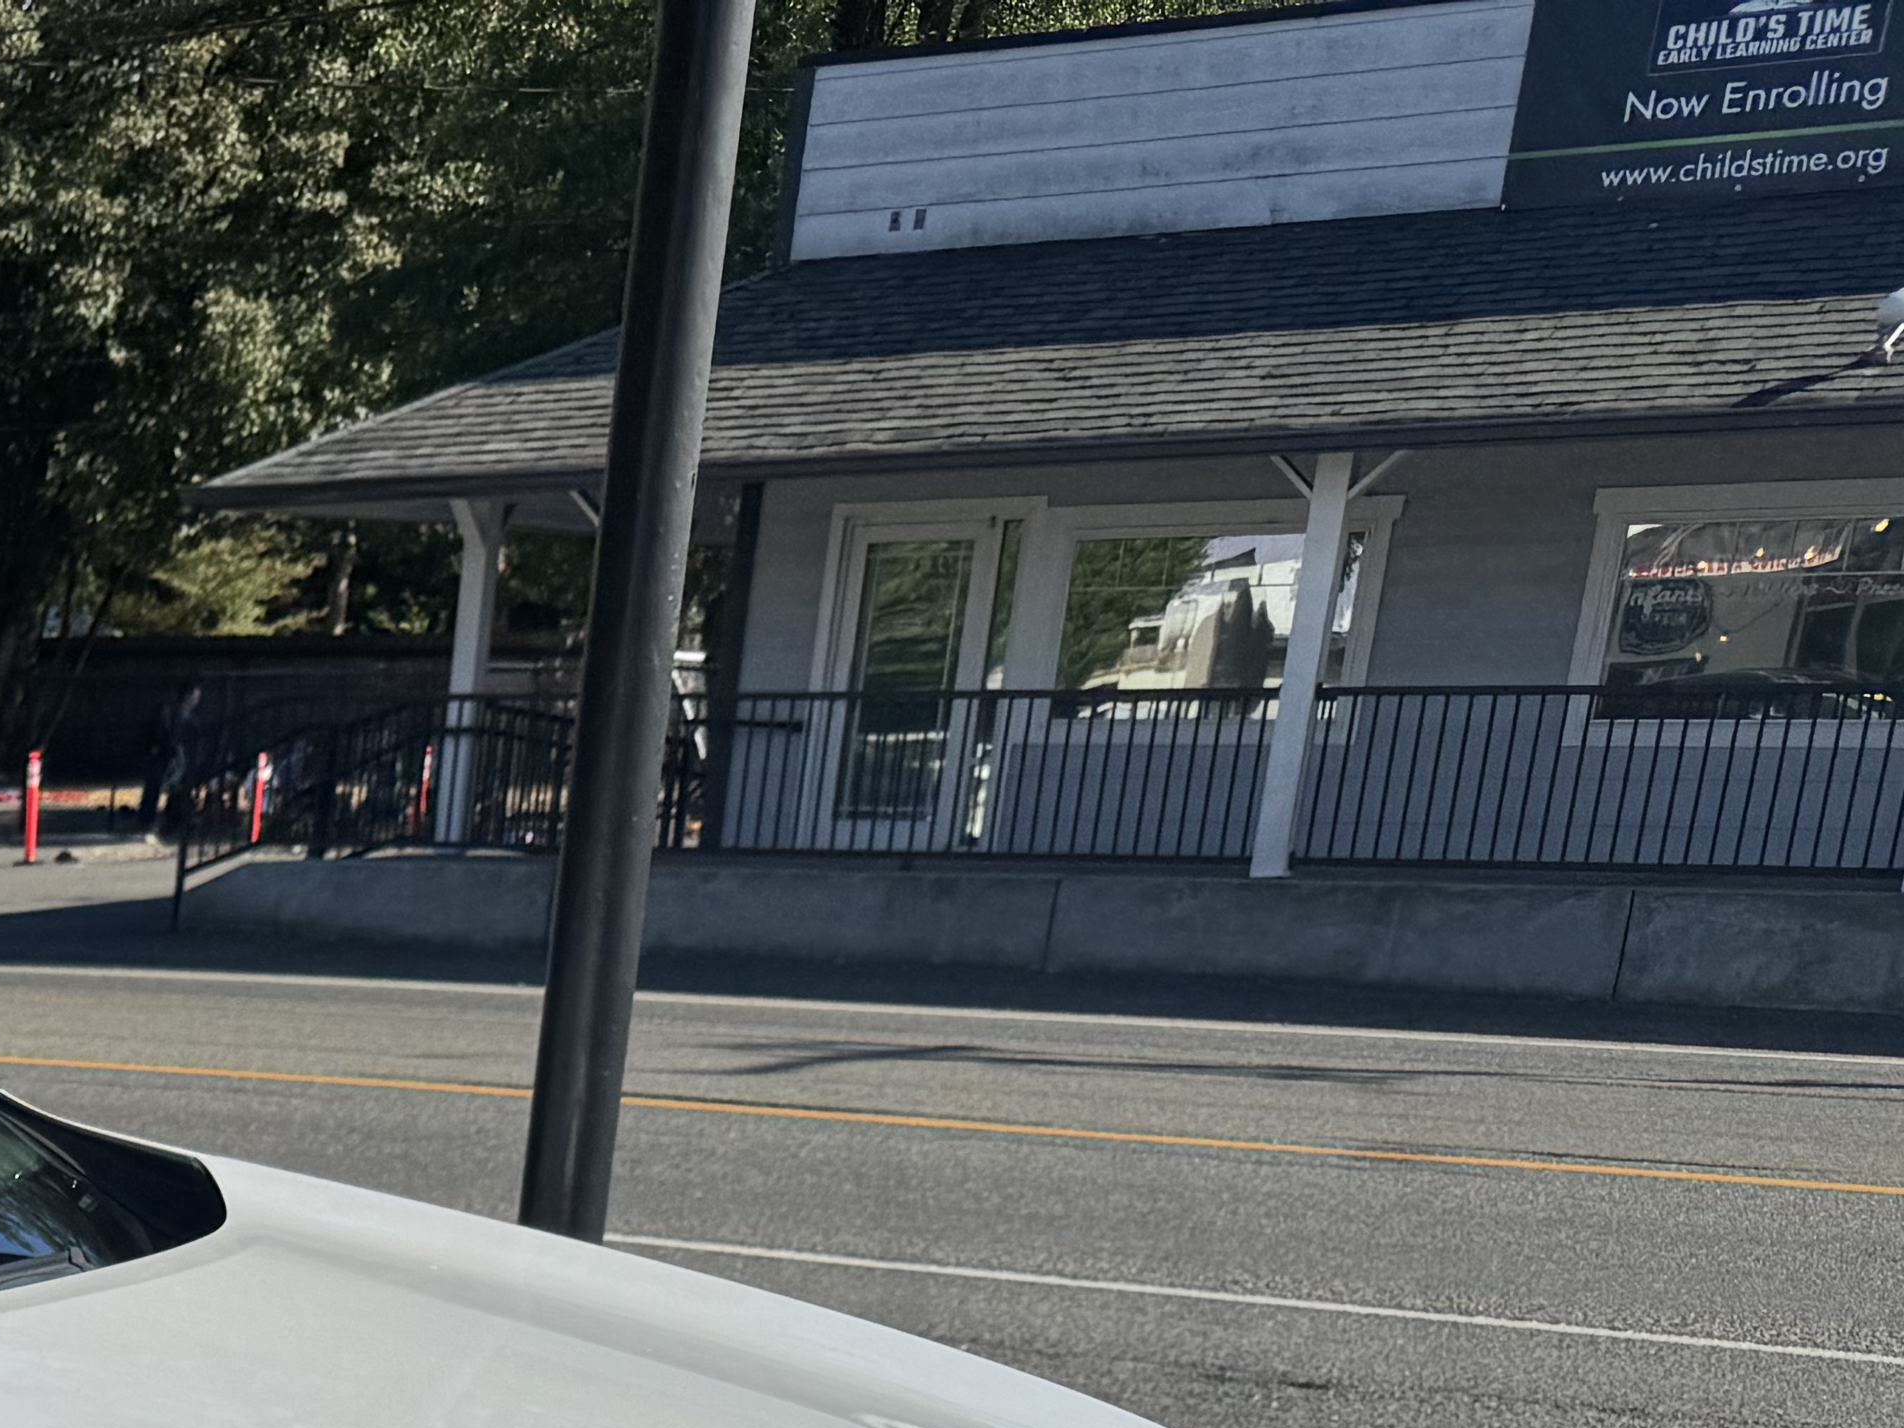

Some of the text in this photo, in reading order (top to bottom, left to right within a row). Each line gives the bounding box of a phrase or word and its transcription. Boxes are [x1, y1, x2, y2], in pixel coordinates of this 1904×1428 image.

[1656, 28, 1873, 66] EARLY LEARNING CENTER
[1666, 3, 1873, 50] CHILD'S TIME
[1623, 70, 1889, 123] Now Enrolling
[1601, 147, 1890, 187] www.childstime.org
